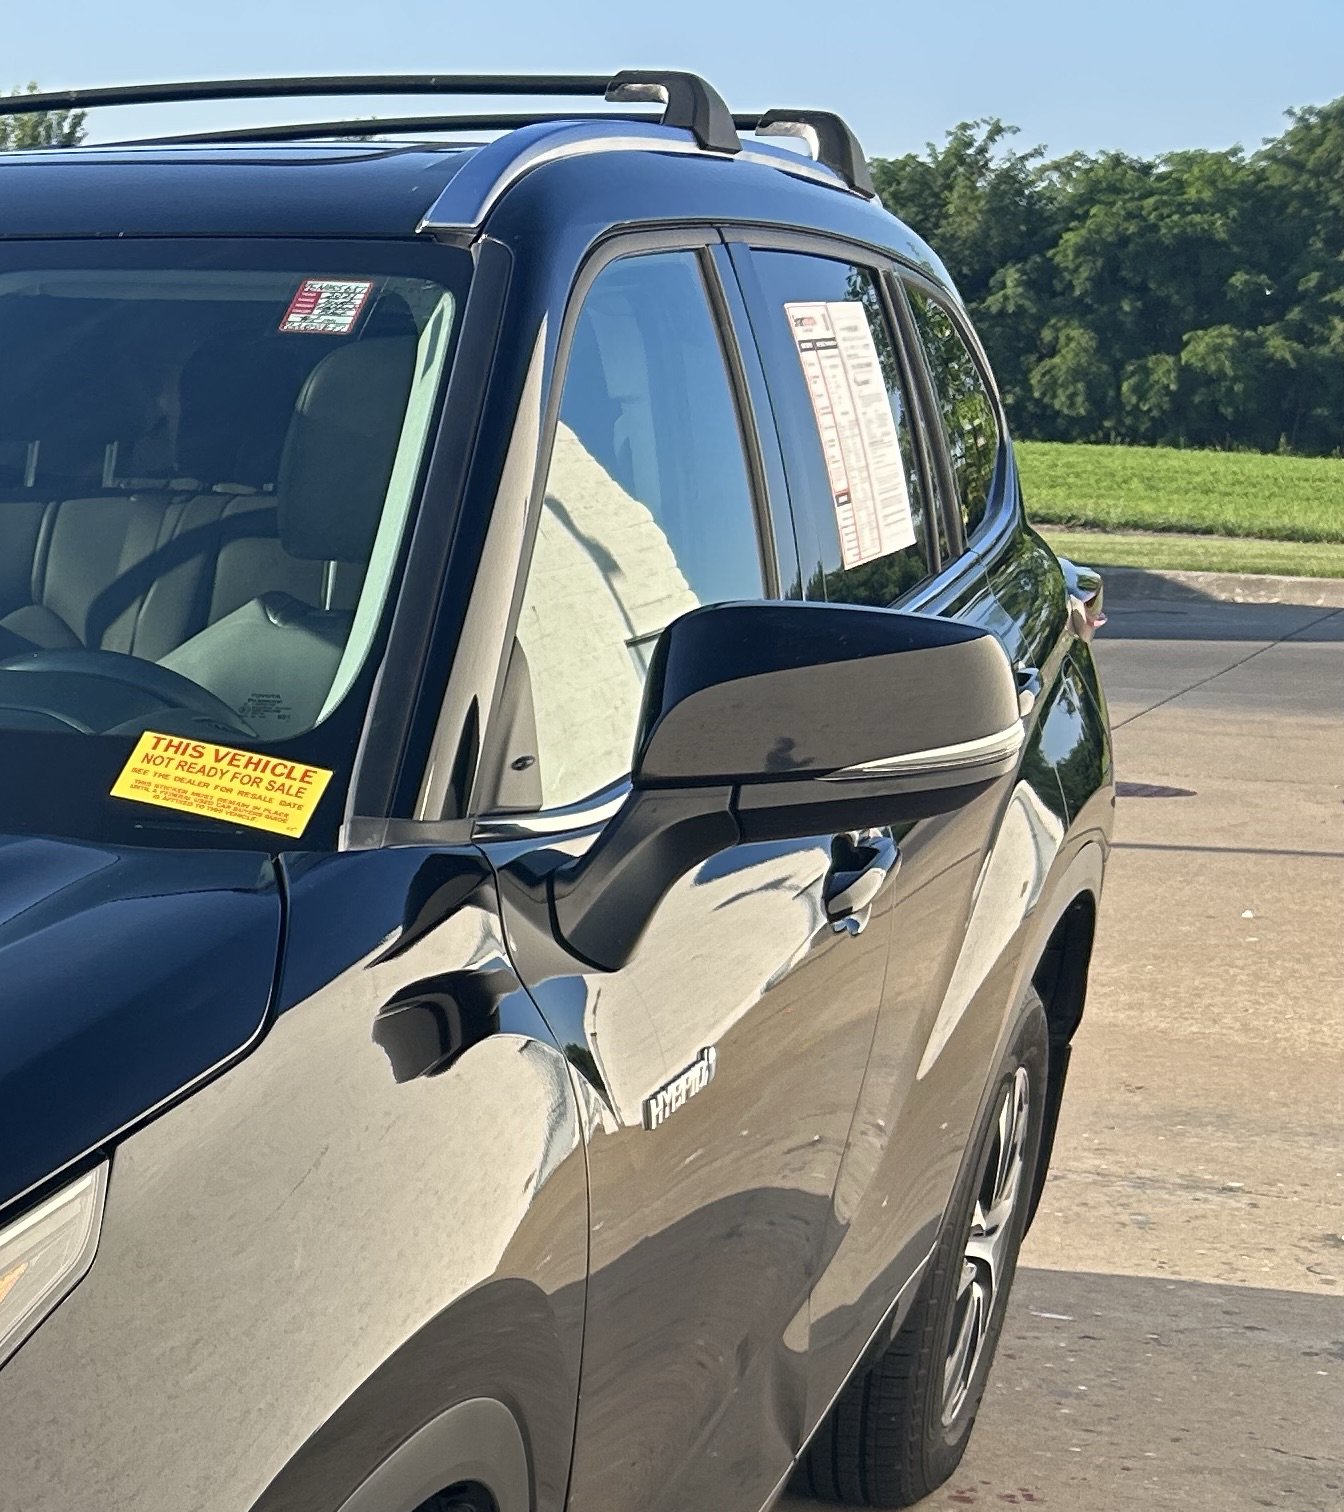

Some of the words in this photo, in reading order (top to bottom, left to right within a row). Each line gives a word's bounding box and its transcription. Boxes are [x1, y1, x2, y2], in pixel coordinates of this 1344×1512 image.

[141, 753, 175, 768] NOT
[175, 760, 230, 780] READY
[230, 772, 263, 788] FOR
[265, 780, 307, 799] SALE
[150, 736, 206, 759] THIS
[214, 749, 317, 785] VEHICLE
[153, 772, 171, 780] THE
[174, 776, 210, 788] DEALER
[214, 785, 233, 794] FOR
[237, 791, 274, 804] RESALE
[279, 800, 304, 811] DATE
